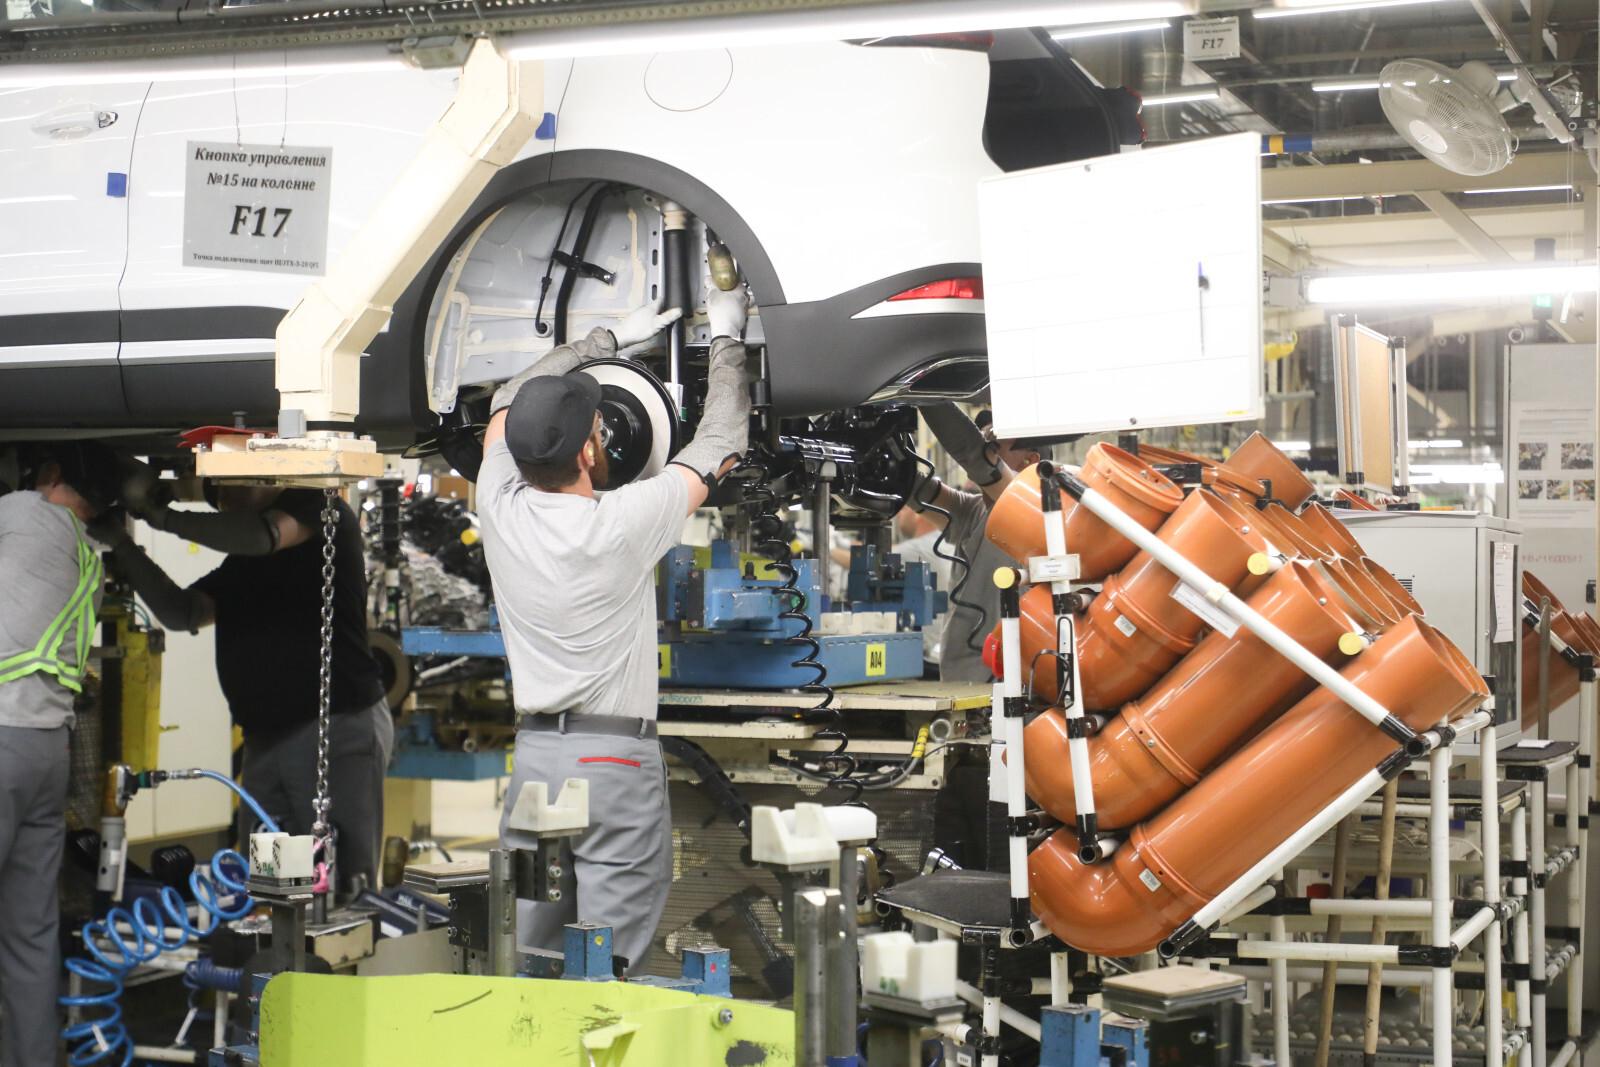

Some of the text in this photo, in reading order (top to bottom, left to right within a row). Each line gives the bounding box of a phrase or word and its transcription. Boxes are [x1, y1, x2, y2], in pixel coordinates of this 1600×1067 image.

[1202, 38, 1224, 49] F17
[194, 147, 326, 168] Кнопка управления
[207, 172, 316, 191] №15 на колонне
[229, 205, 293, 238] F17
[193, 253, 213, 261] Точка
[870, 651, 882, 668] A04
